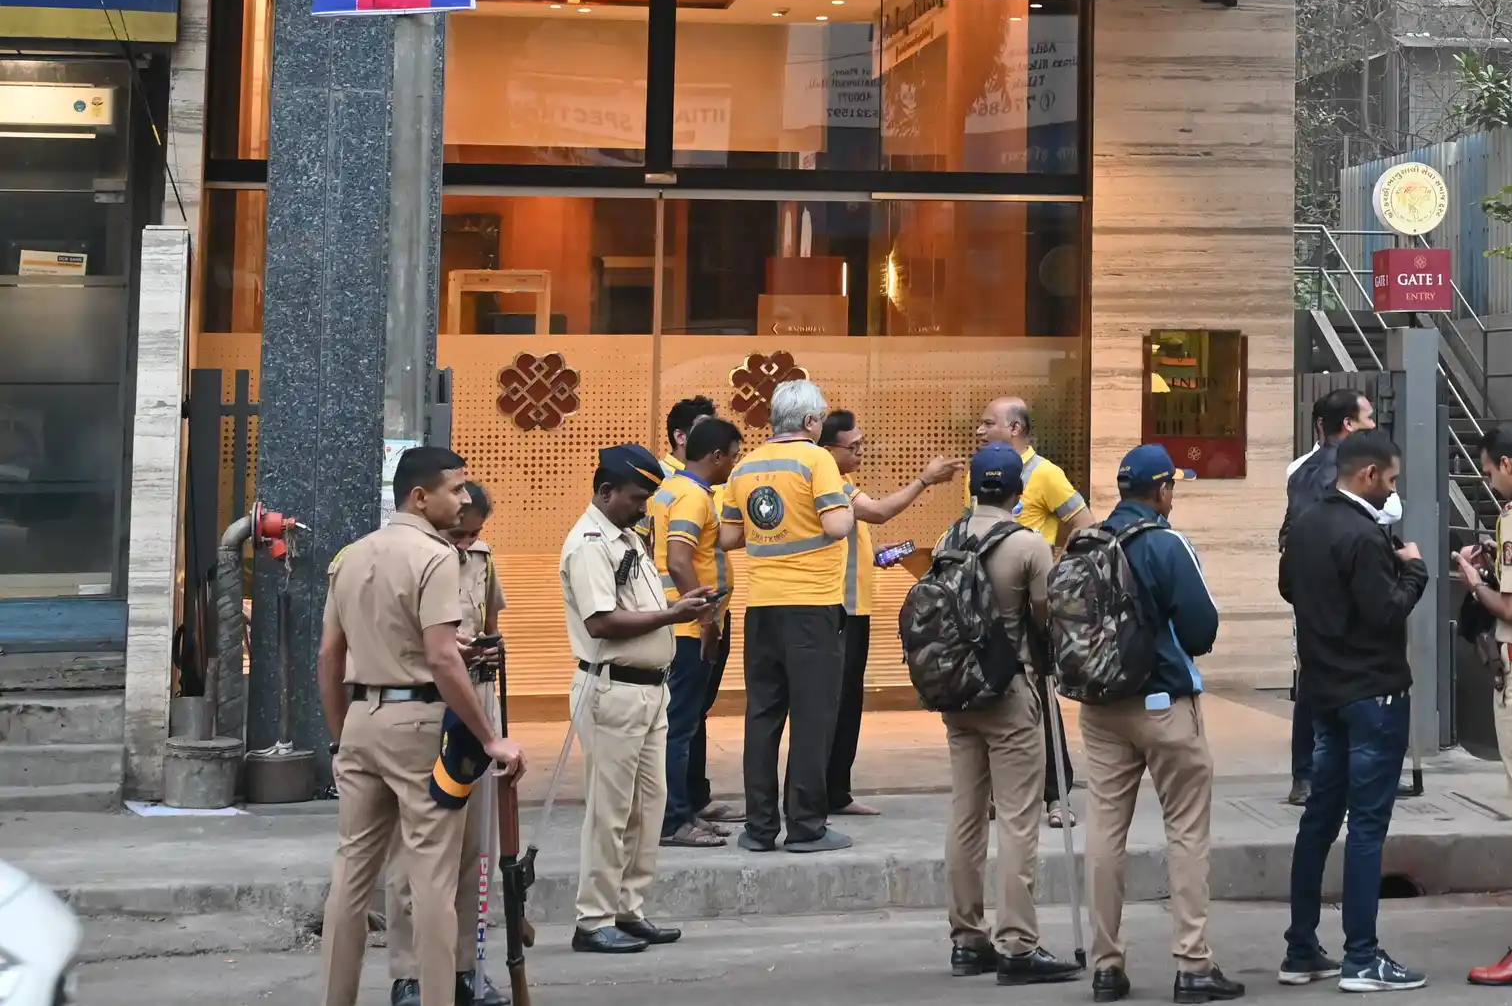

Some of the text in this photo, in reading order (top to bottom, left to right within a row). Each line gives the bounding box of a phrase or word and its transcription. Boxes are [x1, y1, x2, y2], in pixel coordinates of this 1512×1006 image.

[1397, 273, 1444, 286] GATE 1
[1406, 292, 1437, 301] ENTRY
[477, 856, 488, 960] POLICE
